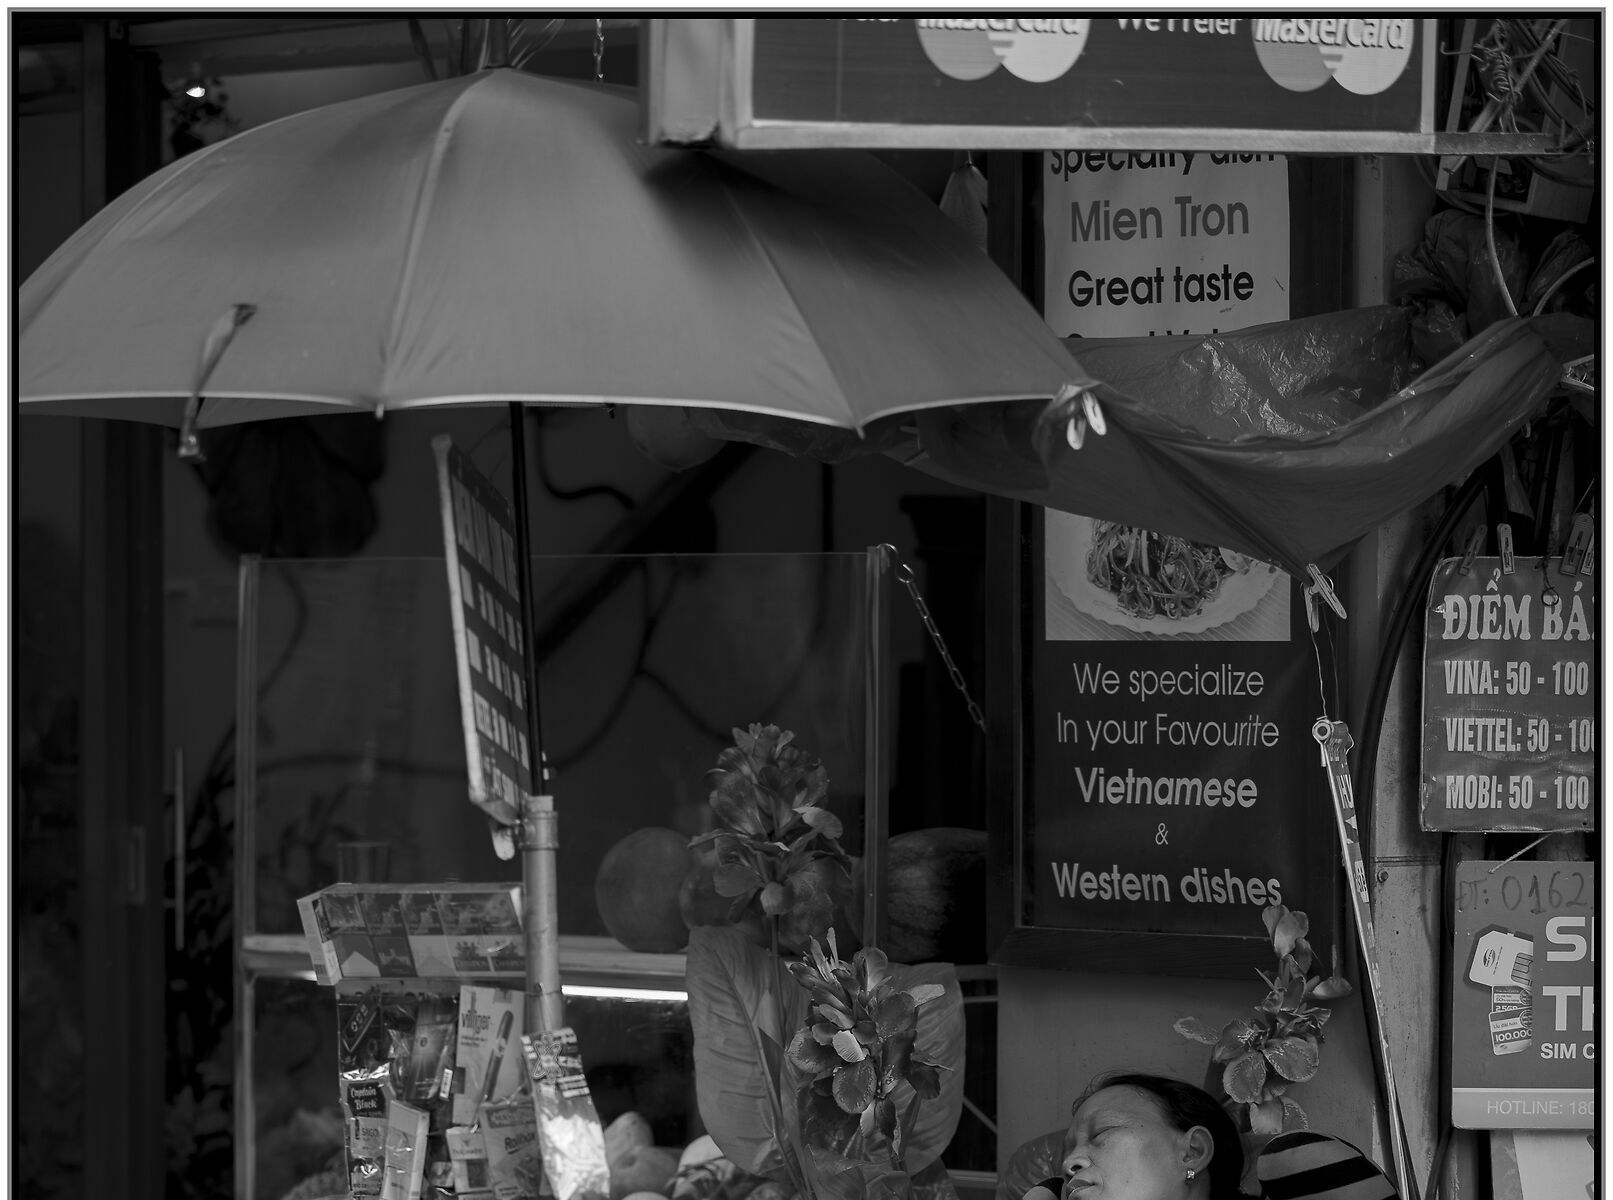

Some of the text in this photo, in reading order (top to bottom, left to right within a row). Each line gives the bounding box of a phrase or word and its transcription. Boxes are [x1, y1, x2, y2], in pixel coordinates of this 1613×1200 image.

[1071, 196, 1249, 242] Mien Tron
[1068, 264, 1254, 307] Great taste
[1442, 568, 1594, 641] ĐIỂM BÁ
[1073, 662, 1265, 702] We specialize
[1444, 660, 1499, 695] VINA:
[1506, 661, 1531, 695] 50
[1553, 661, 1589, 695] 100
[1057, 712, 1280, 751] In your Favourite
[1446, 718, 1521, 752] VIETTEL:
[1527, 719, 1549, 752] 50
[1569, 719, 1594, 752] 10
[1074, 767, 1258, 807] Vietnamese
[1446, 775, 1502, 809] MOBI:
[1509, 775, 1533, 809] 50
[1555, 776, 1589, 809] 100
[1155, 822, 1169, 846] &
[1051, 862, 1283, 906] Western dishes
[1545, 916, 1594, 962] S
[1540, 1043, 1577, 1059] SIM
[1487, 1100, 1563, 1115] HOTLINE:
